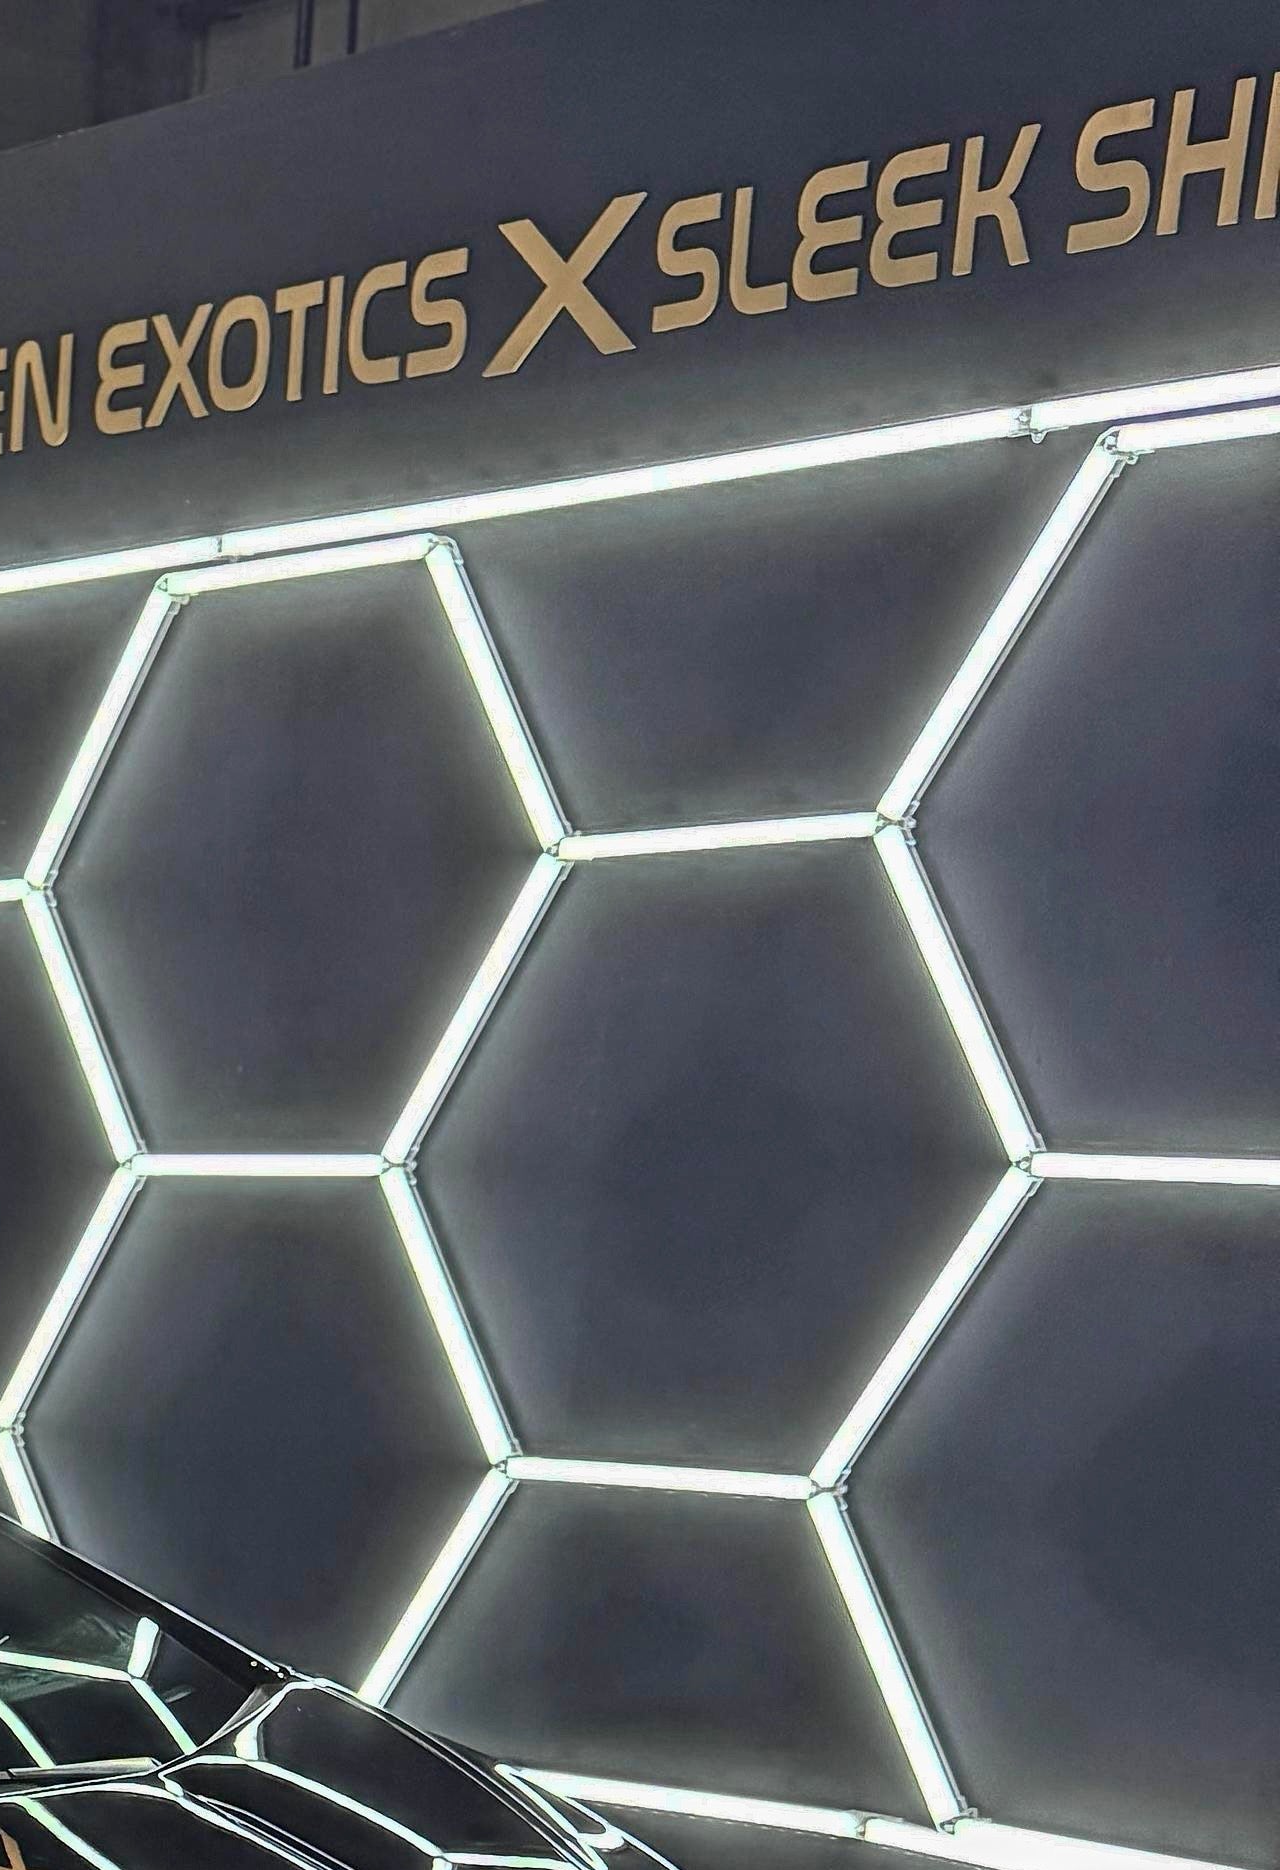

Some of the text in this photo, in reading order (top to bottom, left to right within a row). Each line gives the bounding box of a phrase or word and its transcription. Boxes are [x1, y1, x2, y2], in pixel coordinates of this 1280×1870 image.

[94, 248, 468, 437] EXOTICS
[481, 191, 648, 378] X
[651, 123, 1042, 333] SLEEK
